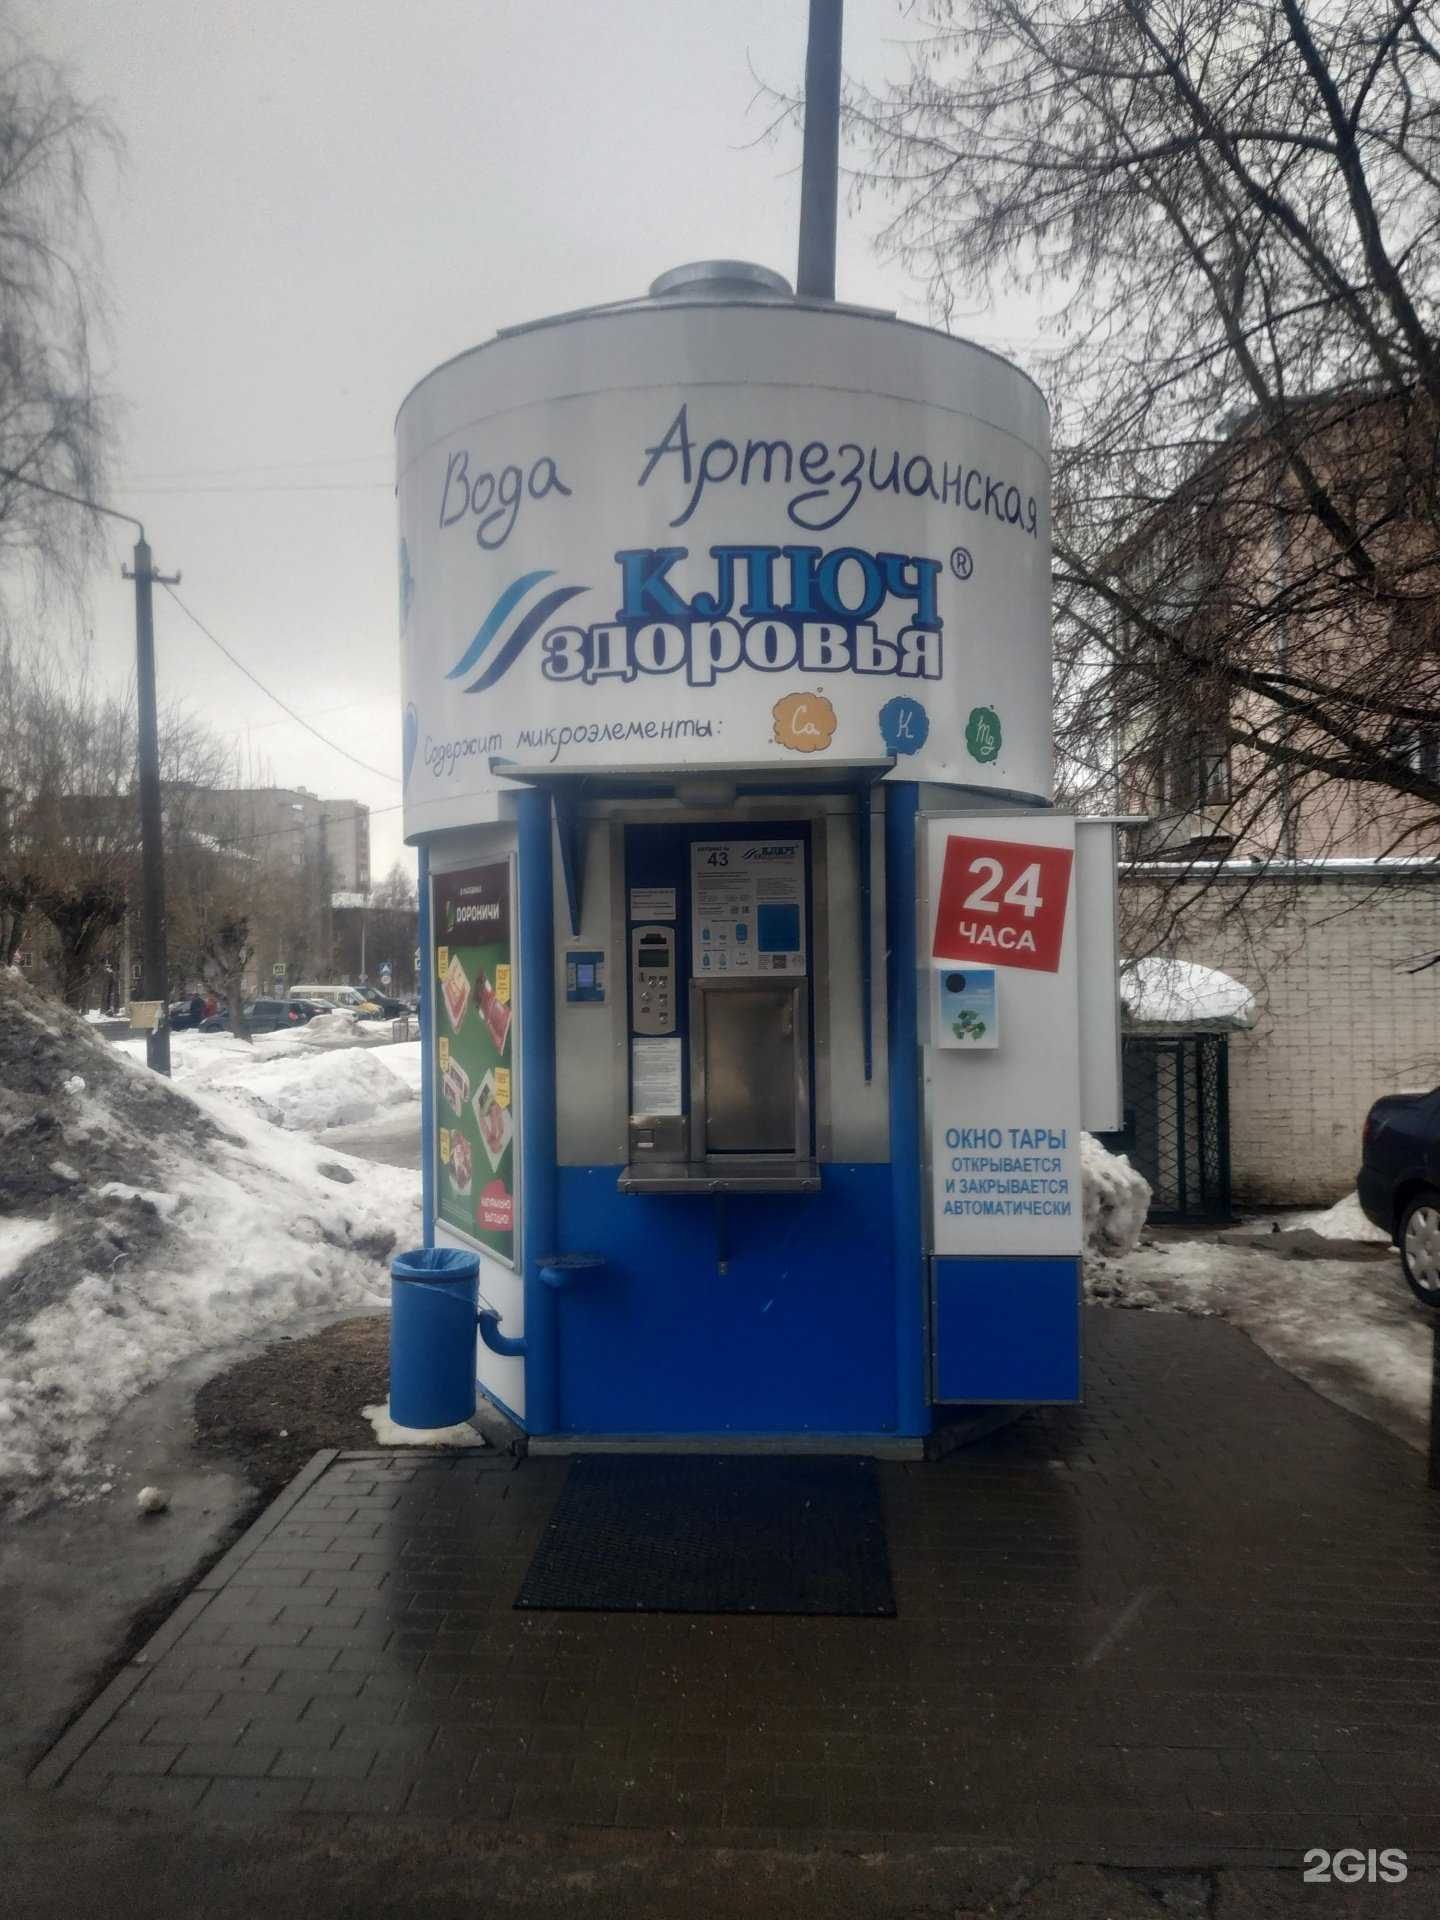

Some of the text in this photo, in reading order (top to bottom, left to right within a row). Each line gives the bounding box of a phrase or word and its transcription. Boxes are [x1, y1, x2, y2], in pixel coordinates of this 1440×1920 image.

[439, 402, 1039, 551] Вода Артезианская
[614, 545, 944, 629] КЛЮЧ
[791, 704, 821, 736] Ca
[424, 718, 724, 777] Содержит микроэлементы:
[707, 851, 729, 867] 43
[962, 857, 1043, 918] 24
[959, 920, 1037, 952] ЧАСА
[945, 1128, 1067, 1149] ОКНО ТАРЫ
[952, 1157, 1062, 1173] ОТКРЫВАЕТСЯ
[944, 1179, 1069, 1194] И ЗАКРЫВАЕТСЯ
[944, 1200, 1072, 1216] АВТОМАТИЧЕСКИ
